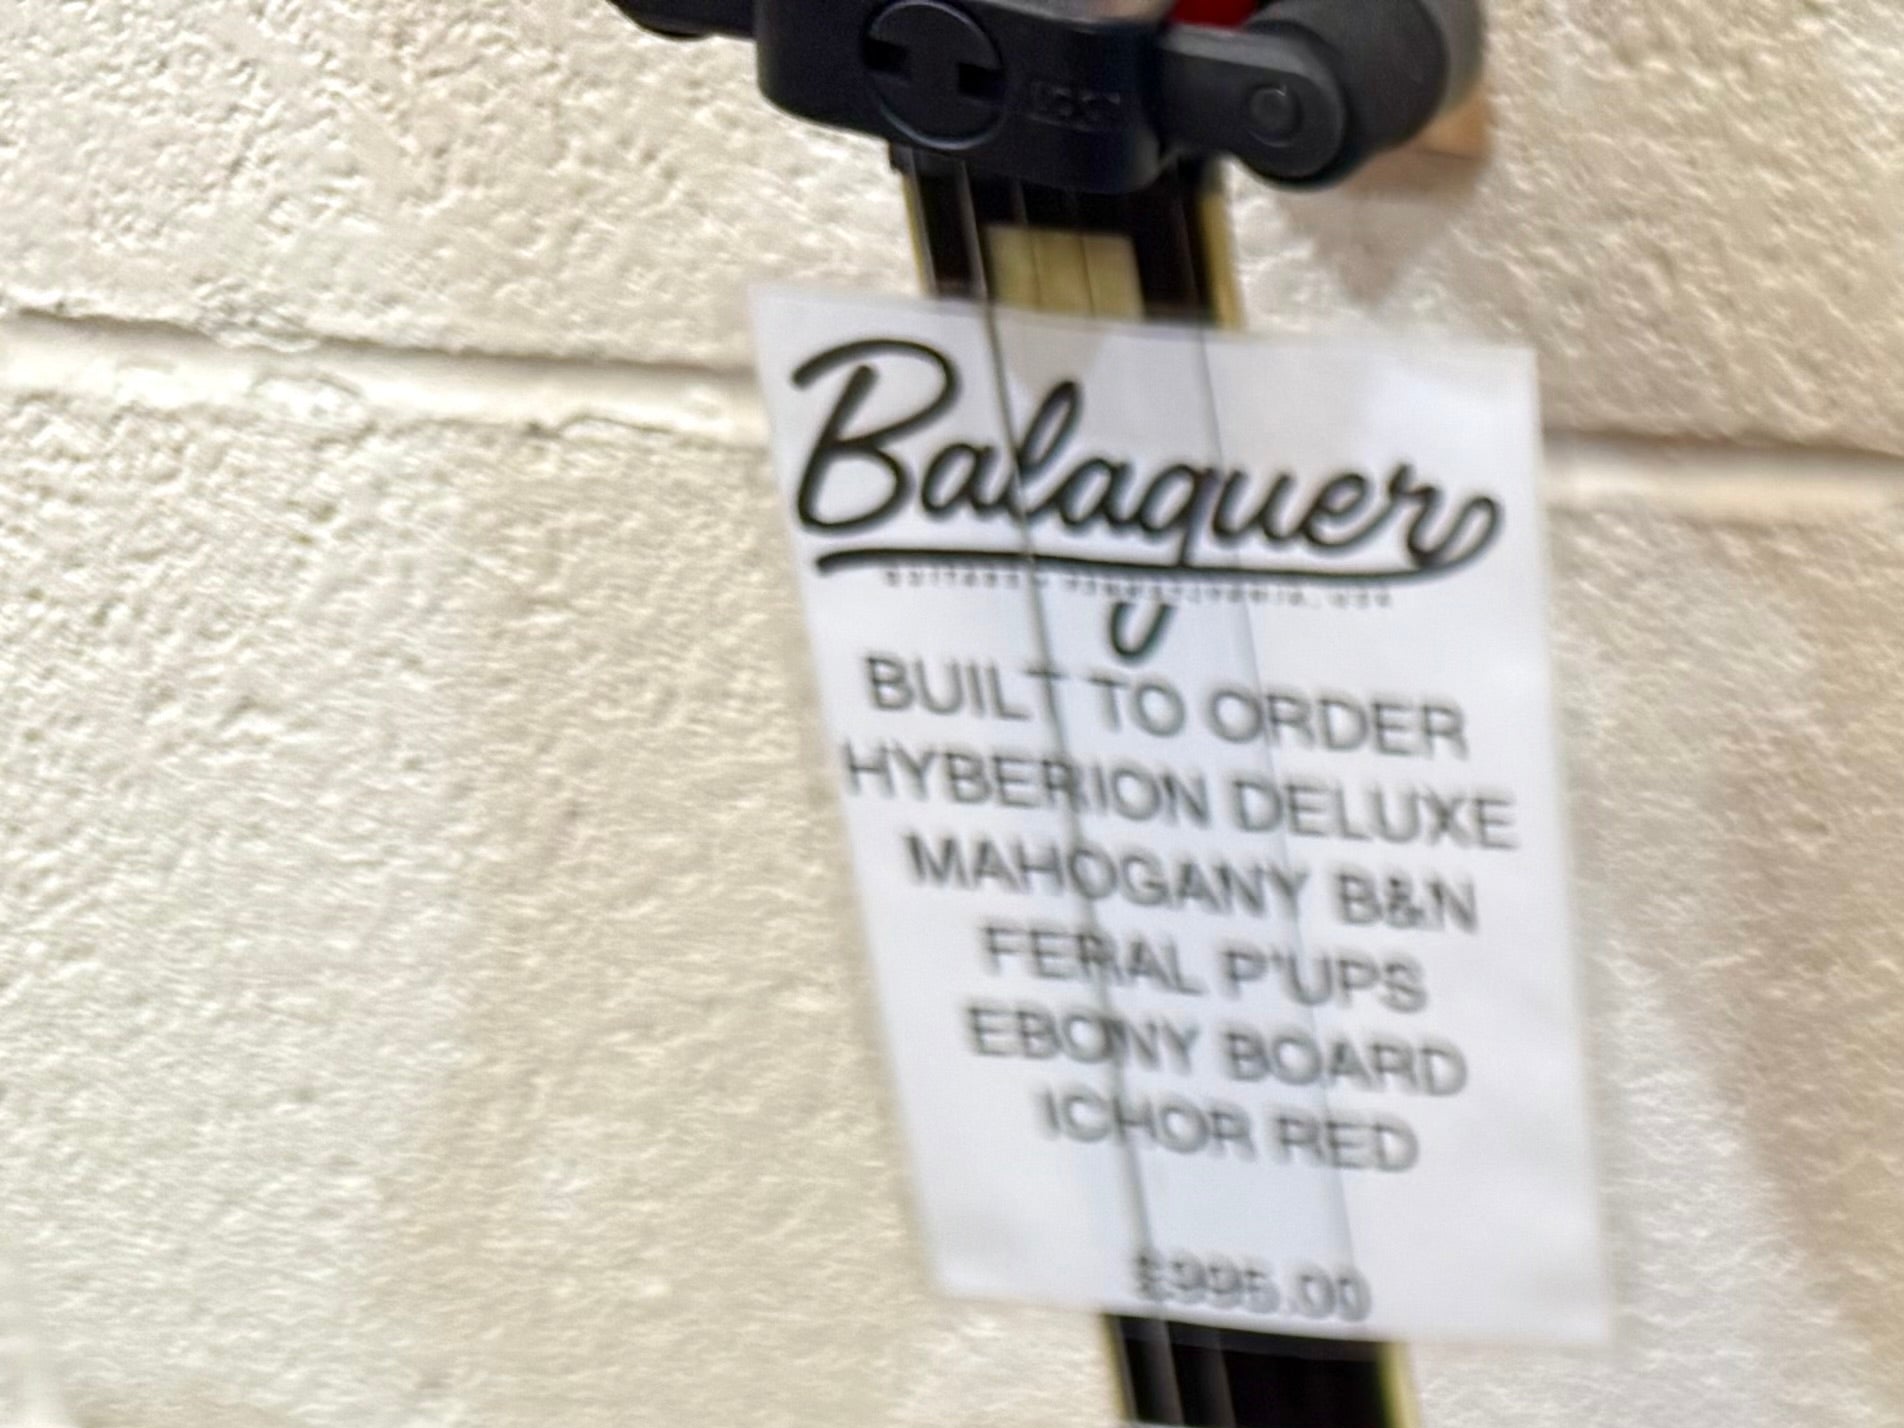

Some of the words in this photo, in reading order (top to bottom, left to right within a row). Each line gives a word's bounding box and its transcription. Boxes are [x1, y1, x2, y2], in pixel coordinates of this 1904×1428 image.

[792, 340, 1505, 663] Balaguer
[866, 654, 1066, 726] BUILT
[1089, 675, 1187, 738] TO
[1205, 686, 1469, 760] ORDER
[841, 740, 1210, 829] HYBERION
[1230, 776, 1518, 851] DELUXE
[903, 830, 1308, 916] MAHOGANY
[1336, 869, 1479, 934] B&N
[981, 922, 1207, 996] FERAL
[966, 1003, 1200, 1077] EBONY
[1224, 1027, 1469, 1098] BOARD
[1035, 1087, 1256, 1163] ICHOR
[1274, 1111, 1420, 1174] RED
